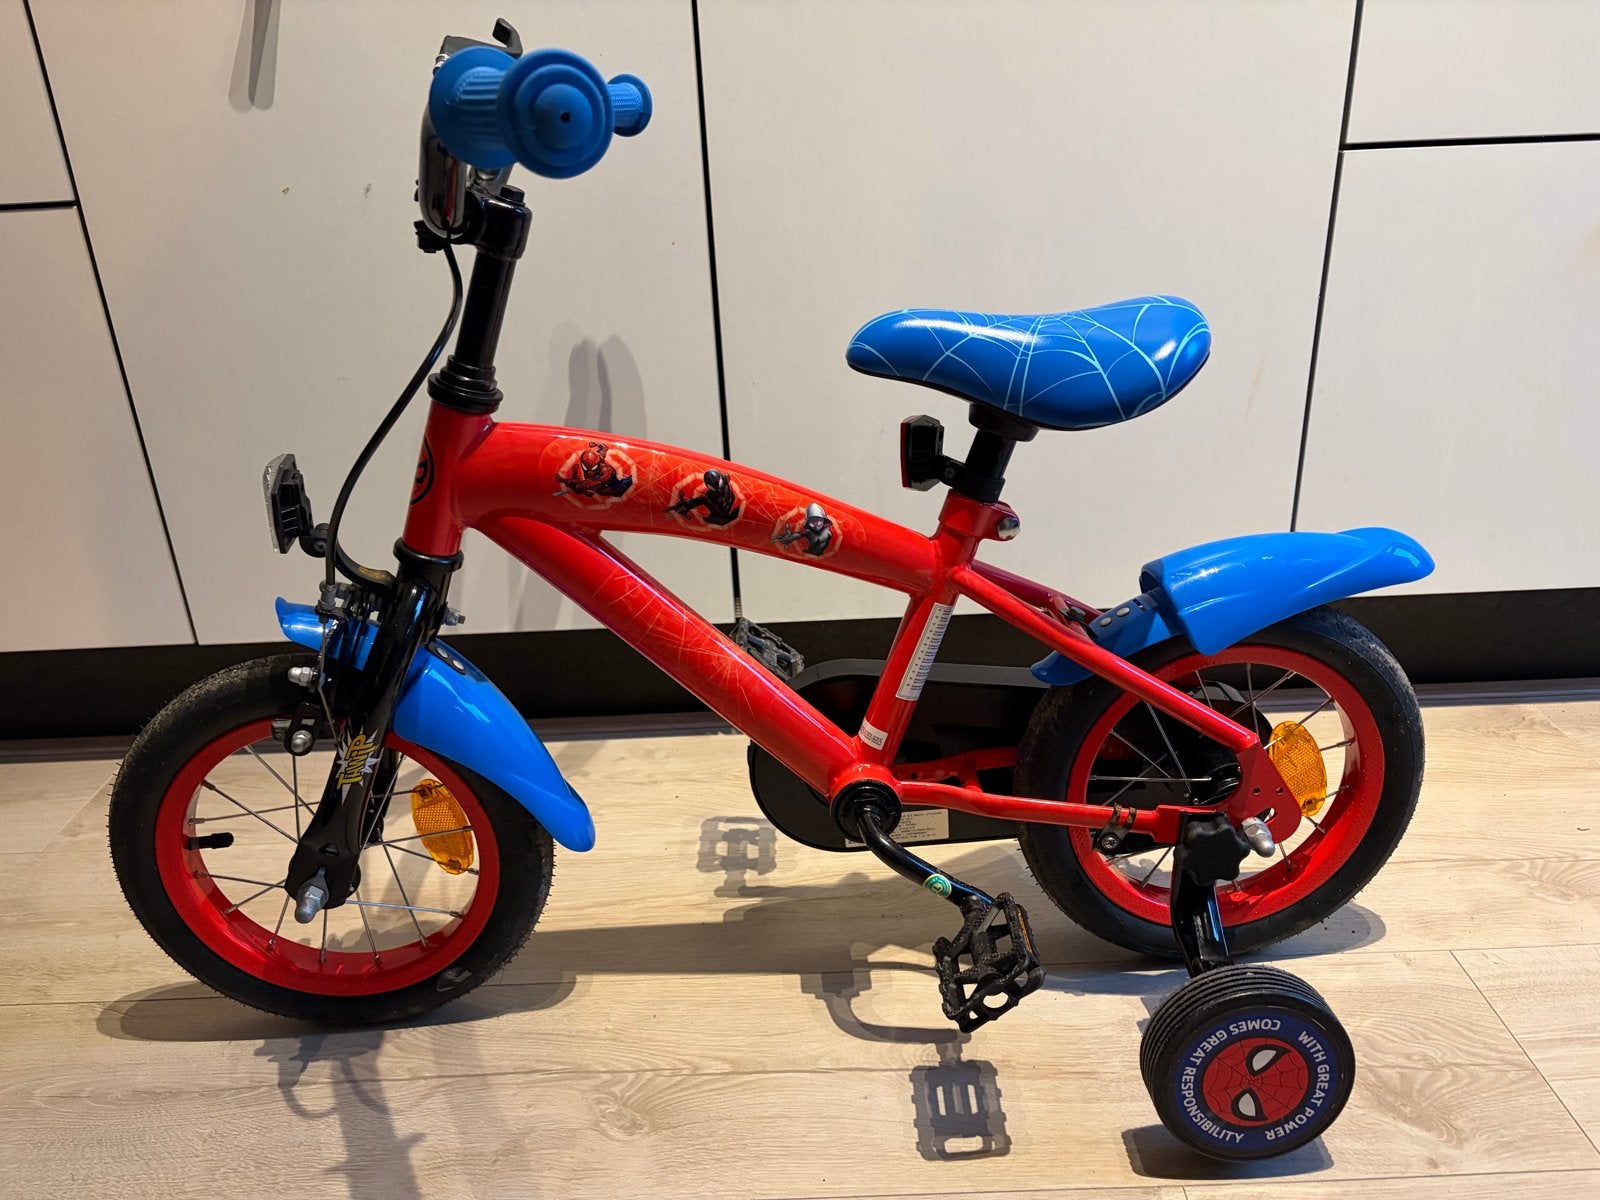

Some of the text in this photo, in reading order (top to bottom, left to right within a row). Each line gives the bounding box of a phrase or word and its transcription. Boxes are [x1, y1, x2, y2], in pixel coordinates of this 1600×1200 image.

[1181, 1018, 1282, 1144] COMES GREAT RESPONSIBILITY
[1264, 1030, 1330, 1141] WITH GREAT POWER
